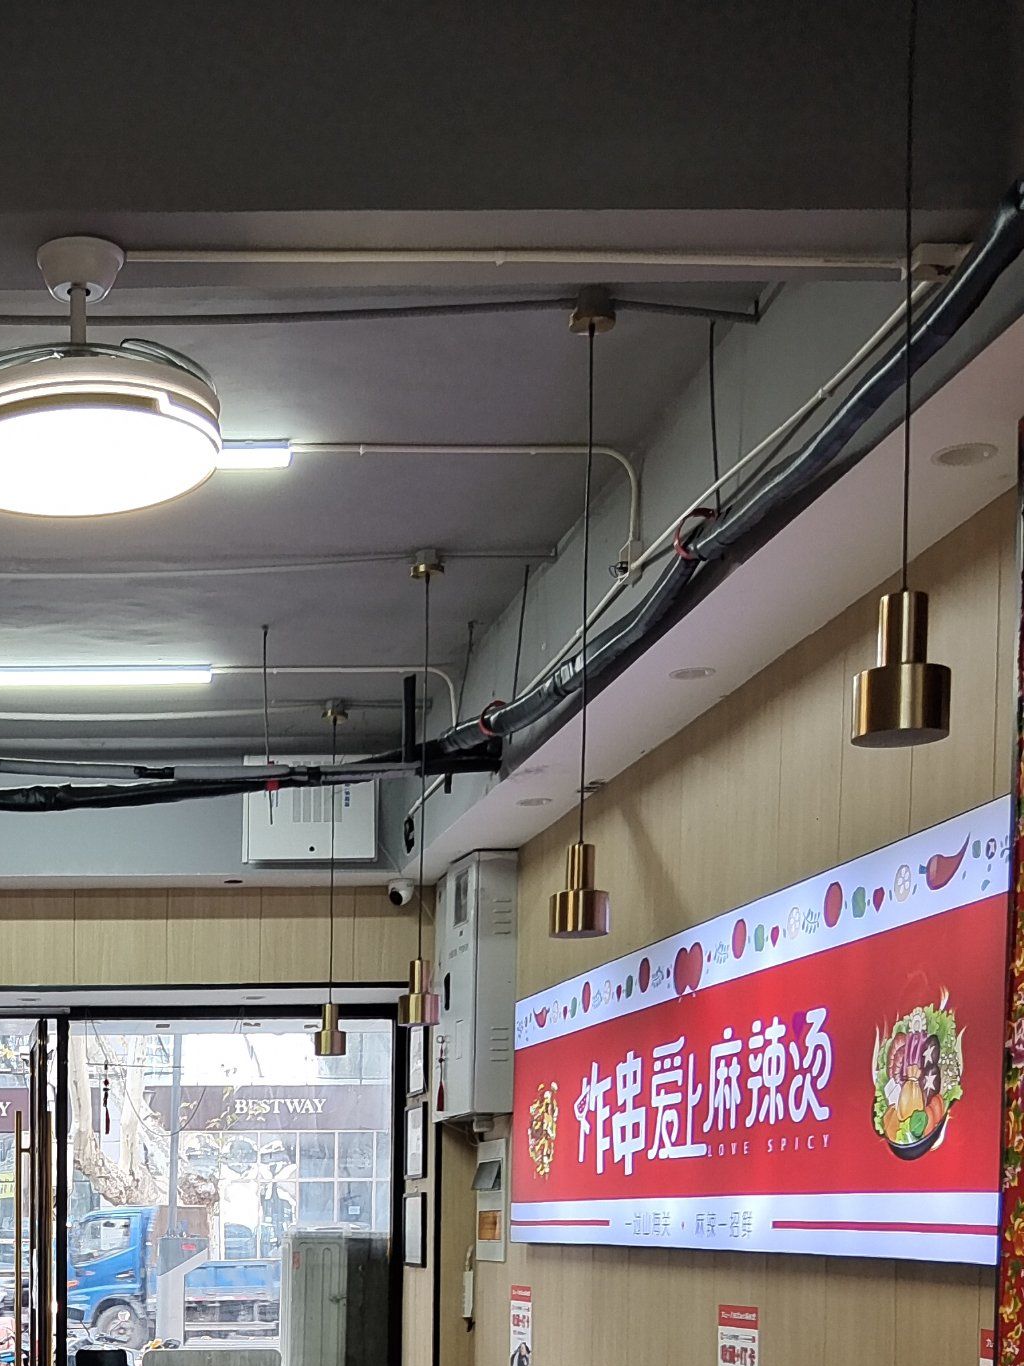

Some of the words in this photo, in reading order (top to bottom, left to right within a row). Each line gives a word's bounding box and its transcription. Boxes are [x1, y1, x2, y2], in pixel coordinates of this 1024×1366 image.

[573, 1007, 832, 1176] 炸串爱上麻辣烫
[707, 1141, 750, 1158] LOVE
[767, 1134, 831, 1153] SPICY
